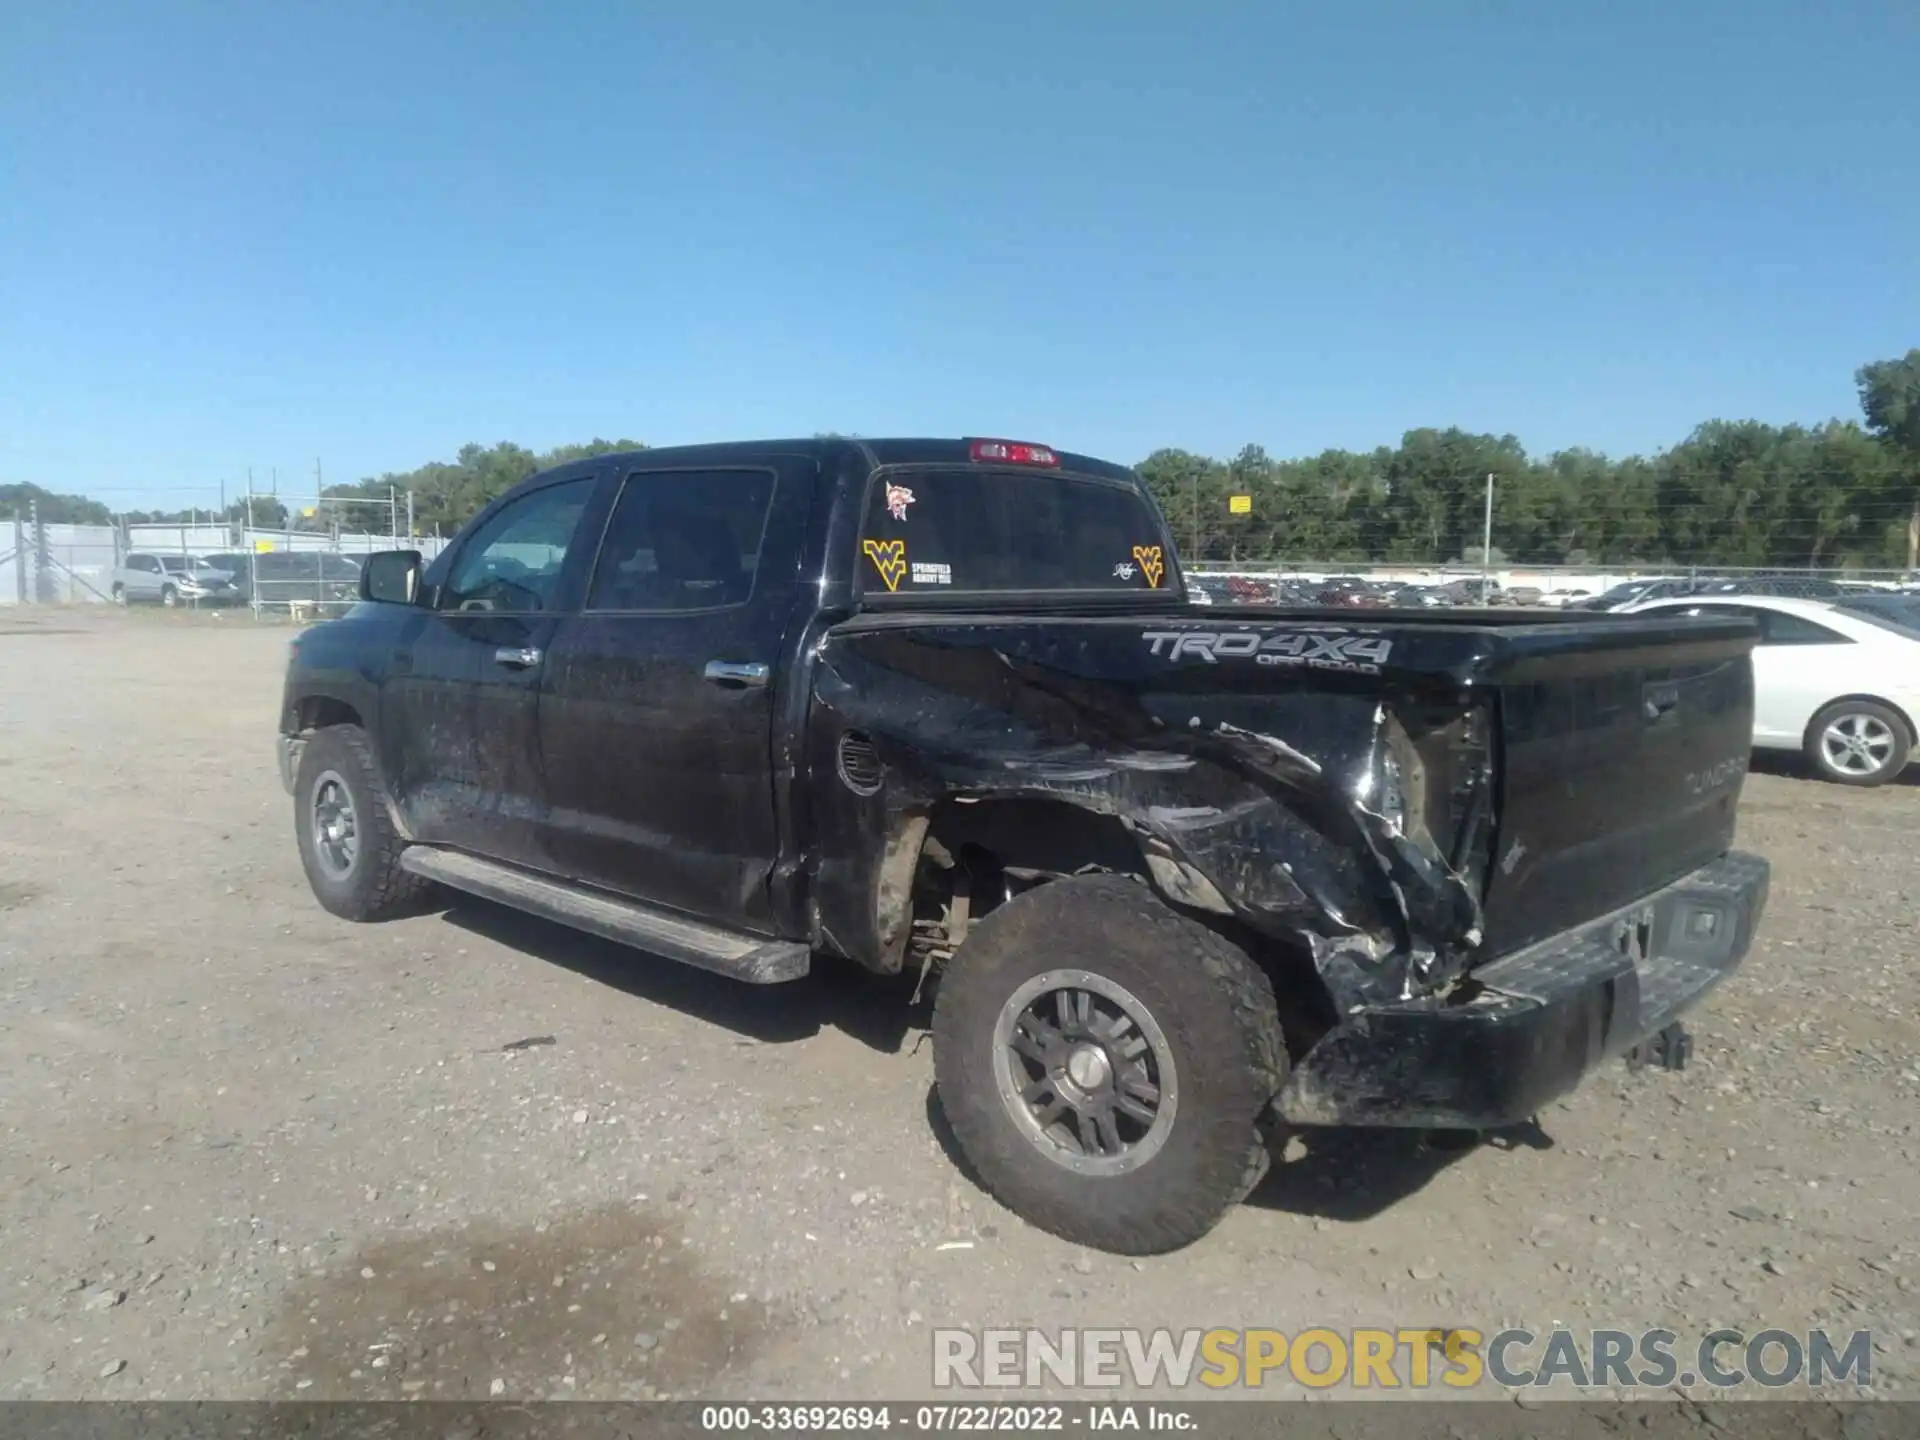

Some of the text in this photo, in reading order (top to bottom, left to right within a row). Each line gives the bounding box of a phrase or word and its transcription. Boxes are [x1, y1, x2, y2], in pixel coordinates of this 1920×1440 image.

[1142, 632, 1260, 663] TRD
[1256, 654, 1382, 675] OFF ROAD
